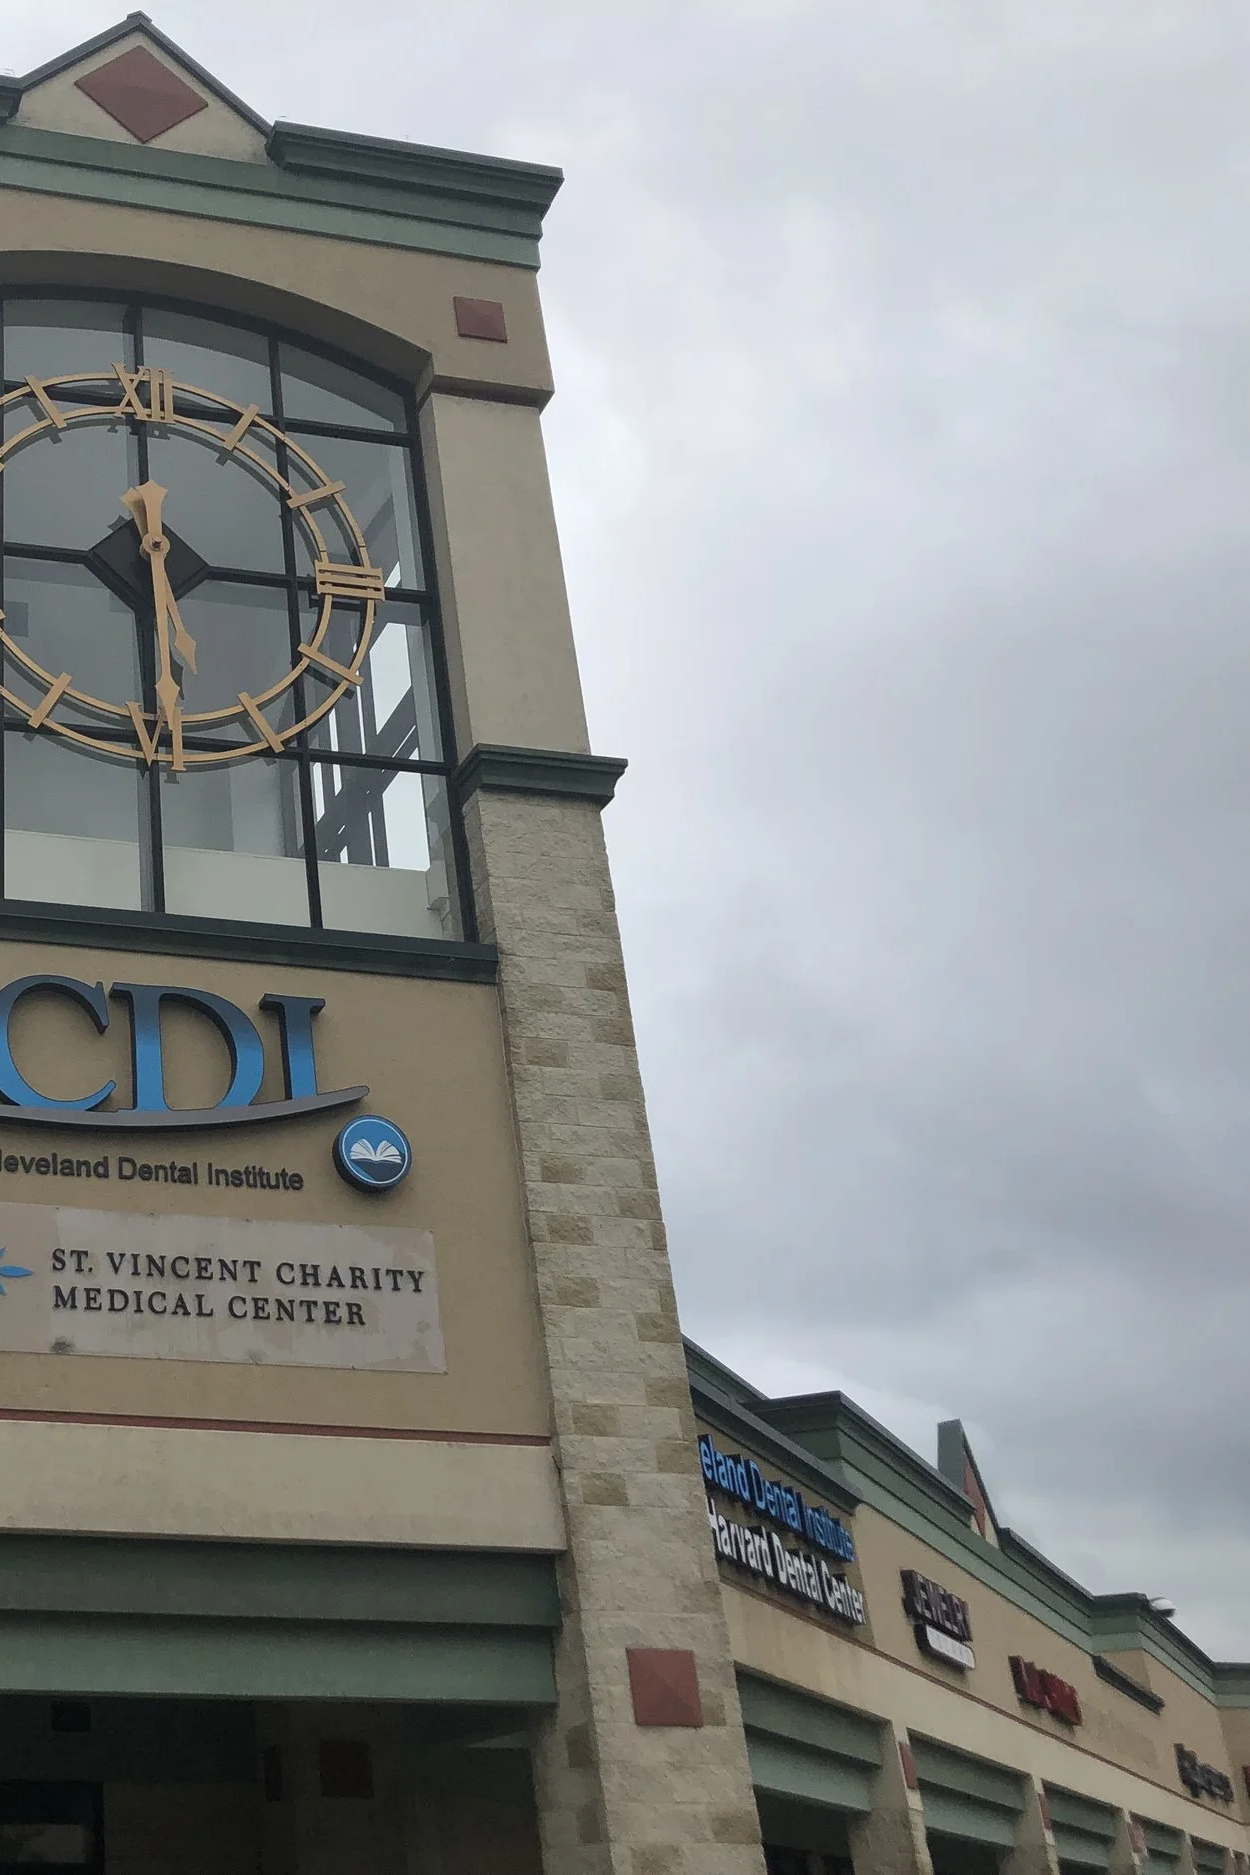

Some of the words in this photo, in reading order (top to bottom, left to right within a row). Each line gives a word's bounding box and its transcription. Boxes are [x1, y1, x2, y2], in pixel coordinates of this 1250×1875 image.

[118, 1156, 198, 1185] Dental
[208, 1162, 304, 1191] Institute
[52, 1249, 93, 1273] ST.
[106, 1252, 261, 1283] VINCENT
[276, 1262, 424, 1293] CHARITY
[53, 1285, 214, 1317] MEDICAL
[228, 1296, 366, 1326] CENTER
[700, 1434, 751, 1502] eland
[750, 1460, 803, 1532] Dental
[706, 1498, 774, 1578] Harvard
[771, 1532, 824, 1603] Dental
[821, 1559, 867, 1625] Center
